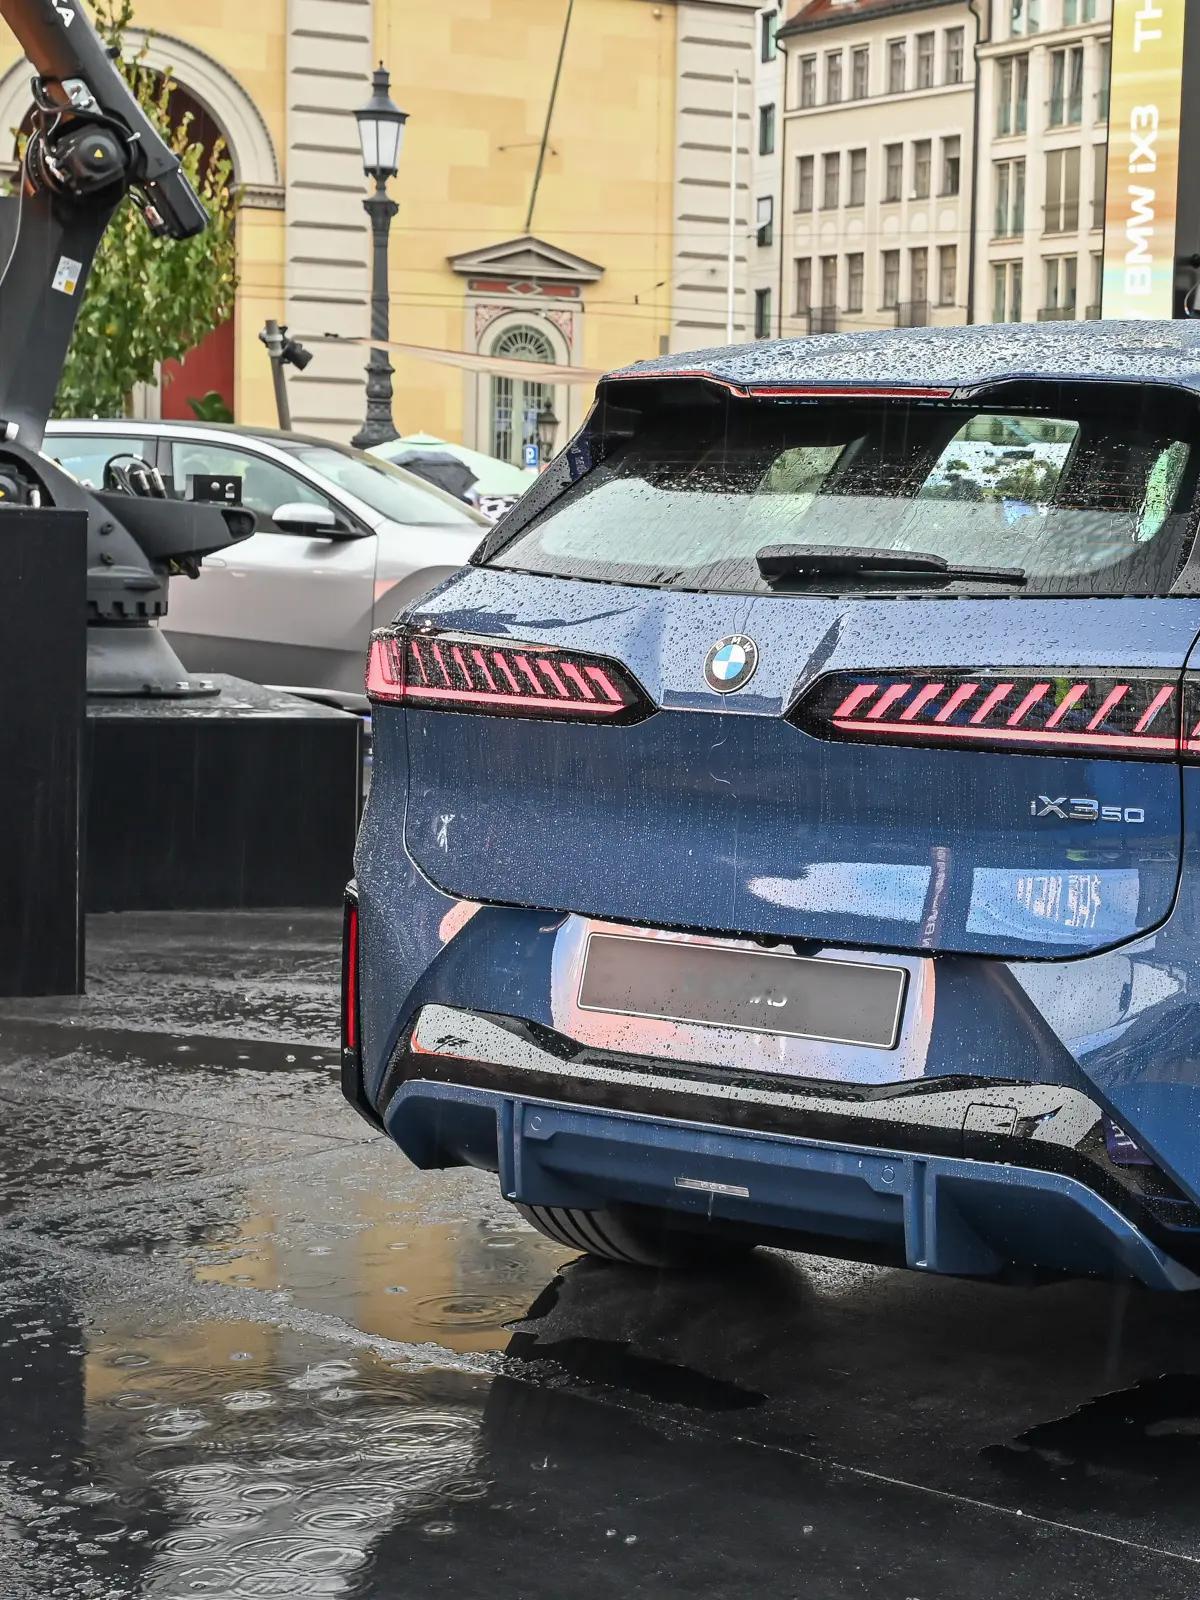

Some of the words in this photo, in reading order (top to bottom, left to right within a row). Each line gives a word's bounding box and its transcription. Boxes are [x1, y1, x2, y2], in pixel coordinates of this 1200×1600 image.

[1129, 104, 1159, 173] iX3
[1124, 185, 1156, 295] BMW
[715, 636, 754, 653] BMW
